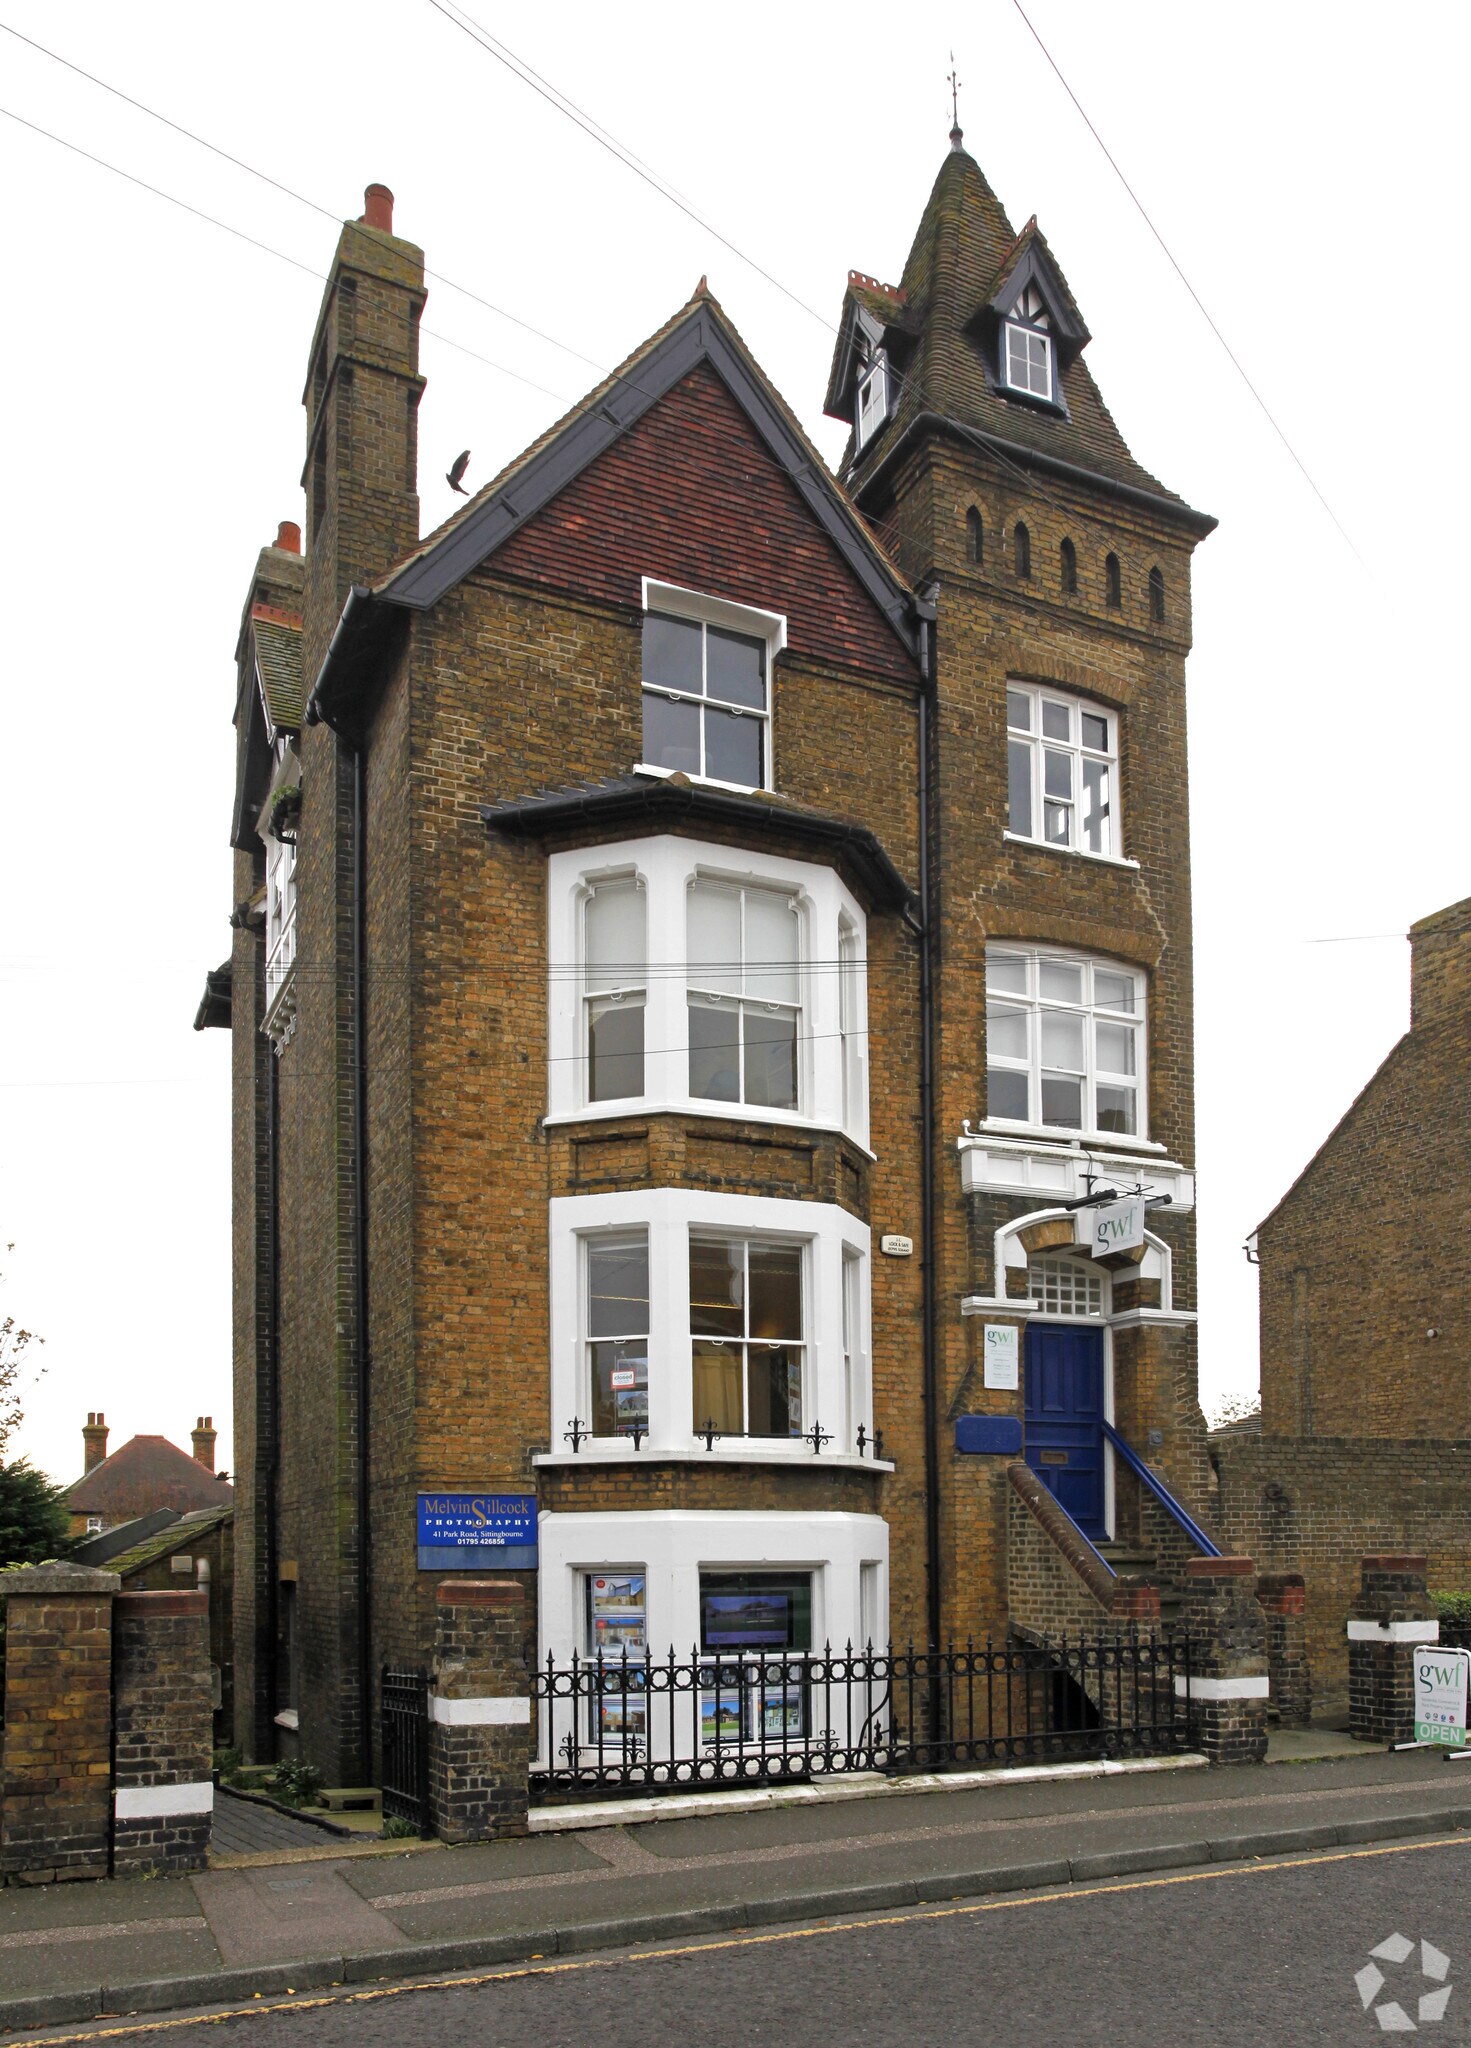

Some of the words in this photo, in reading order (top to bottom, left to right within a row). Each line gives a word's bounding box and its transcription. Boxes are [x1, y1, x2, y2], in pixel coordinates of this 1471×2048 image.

[1097, 1206, 1138, 1253] gwf
[614, 1373, 633, 1381] closed
[425, 1499, 471, 1514] Melvin
[471, 1499, 529, 1529] Sillcock
[460, 1531, 479, 1539] Road,
[480, 1531, 524, 1539] Sittingbourne
[1419, 1661, 1464, 1694] gwf
[1420, 1723, 1460, 1743] OPEN
